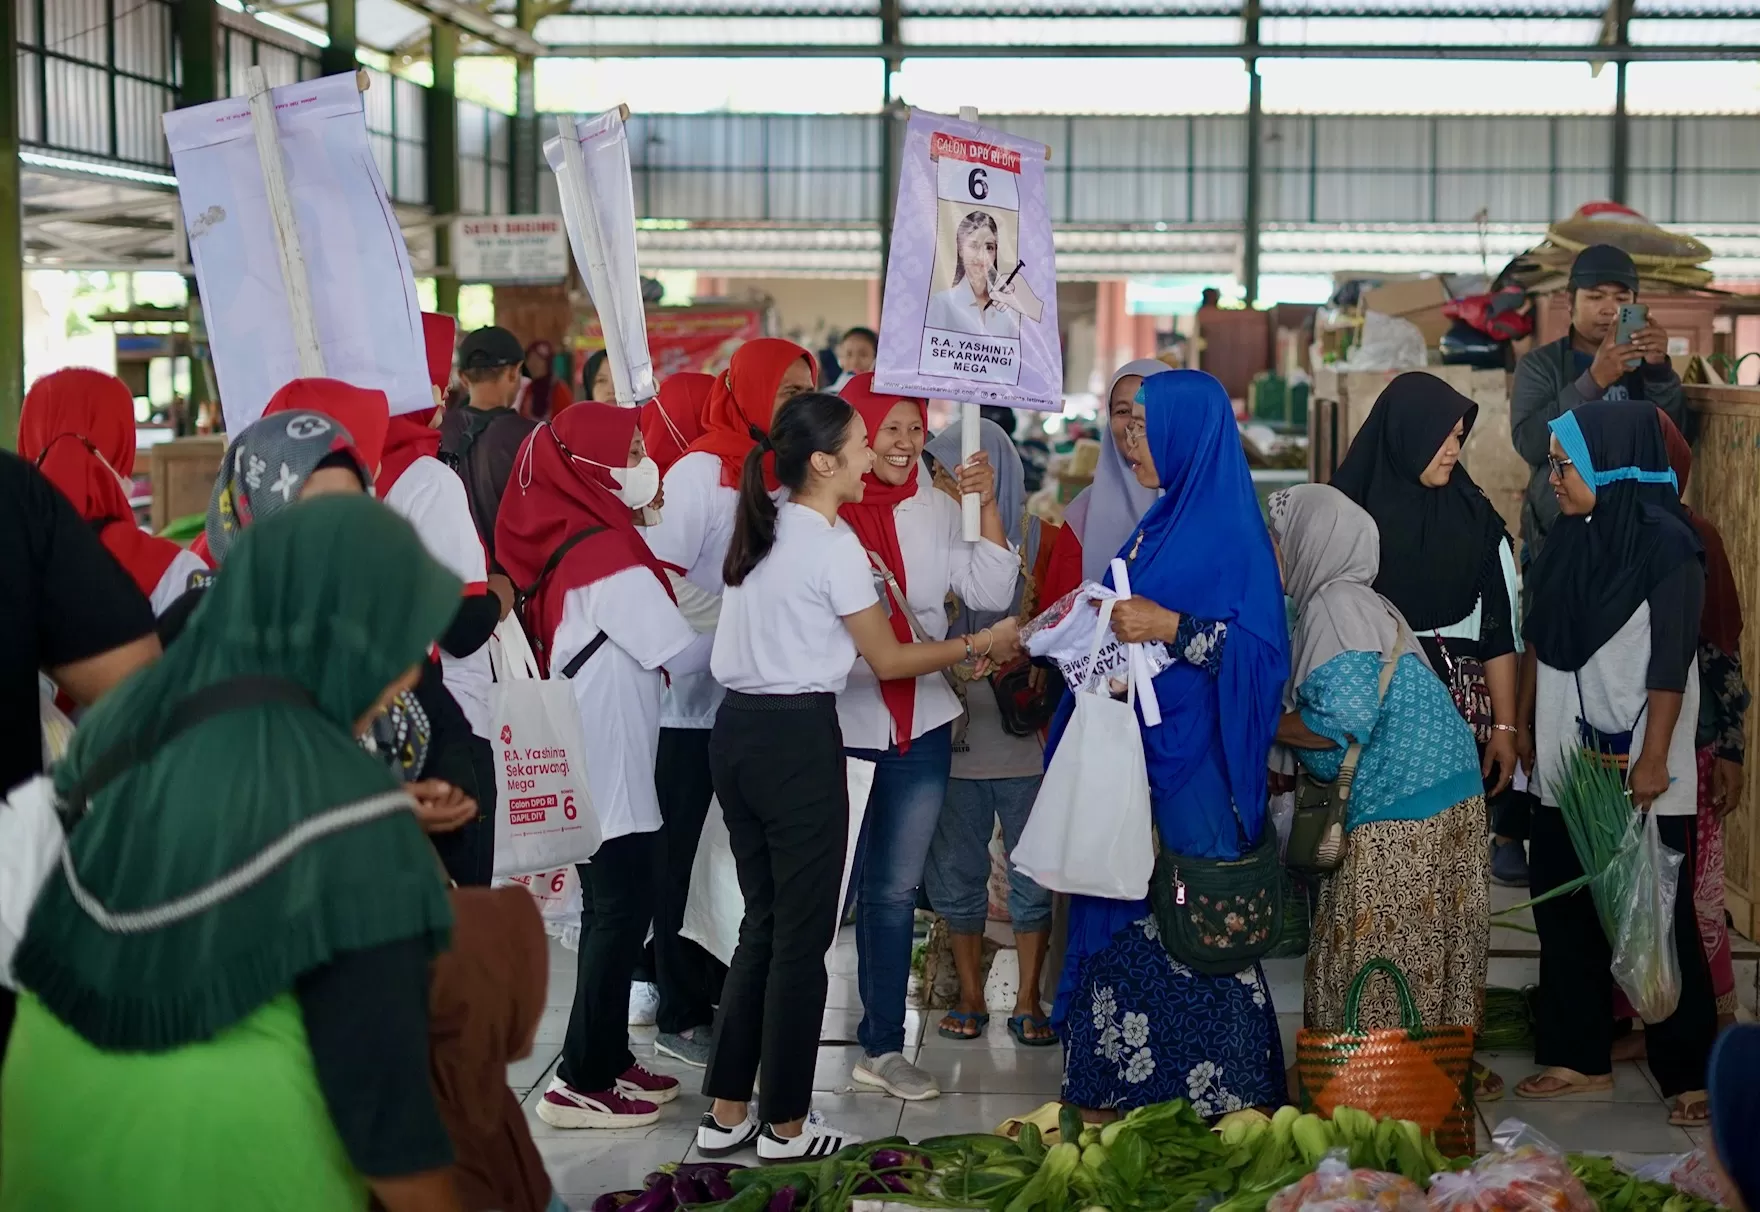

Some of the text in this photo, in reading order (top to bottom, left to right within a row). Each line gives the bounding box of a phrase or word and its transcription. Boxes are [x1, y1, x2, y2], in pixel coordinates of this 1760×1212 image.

[936, 137, 1016, 168] CALON DPD RI DIY
[968, 168, 989, 200] 6
[931, 336, 1015, 356] R.A. YASHINTA
[932, 348, 1012, 366] SEKARWANGI
[953, 361, 987, 374] MEGA
[503, 749, 523, 762] R.A.
[506, 759, 570, 778] Sekarwangi
[507, 779, 535, 793] Mega
[511, 797, 555, 809] Calon DPD RI
[563, 795, 578, 821] 6
[511, 811, 544, 823] DAPIL DIY
[551, 873, 565, 893] 6
